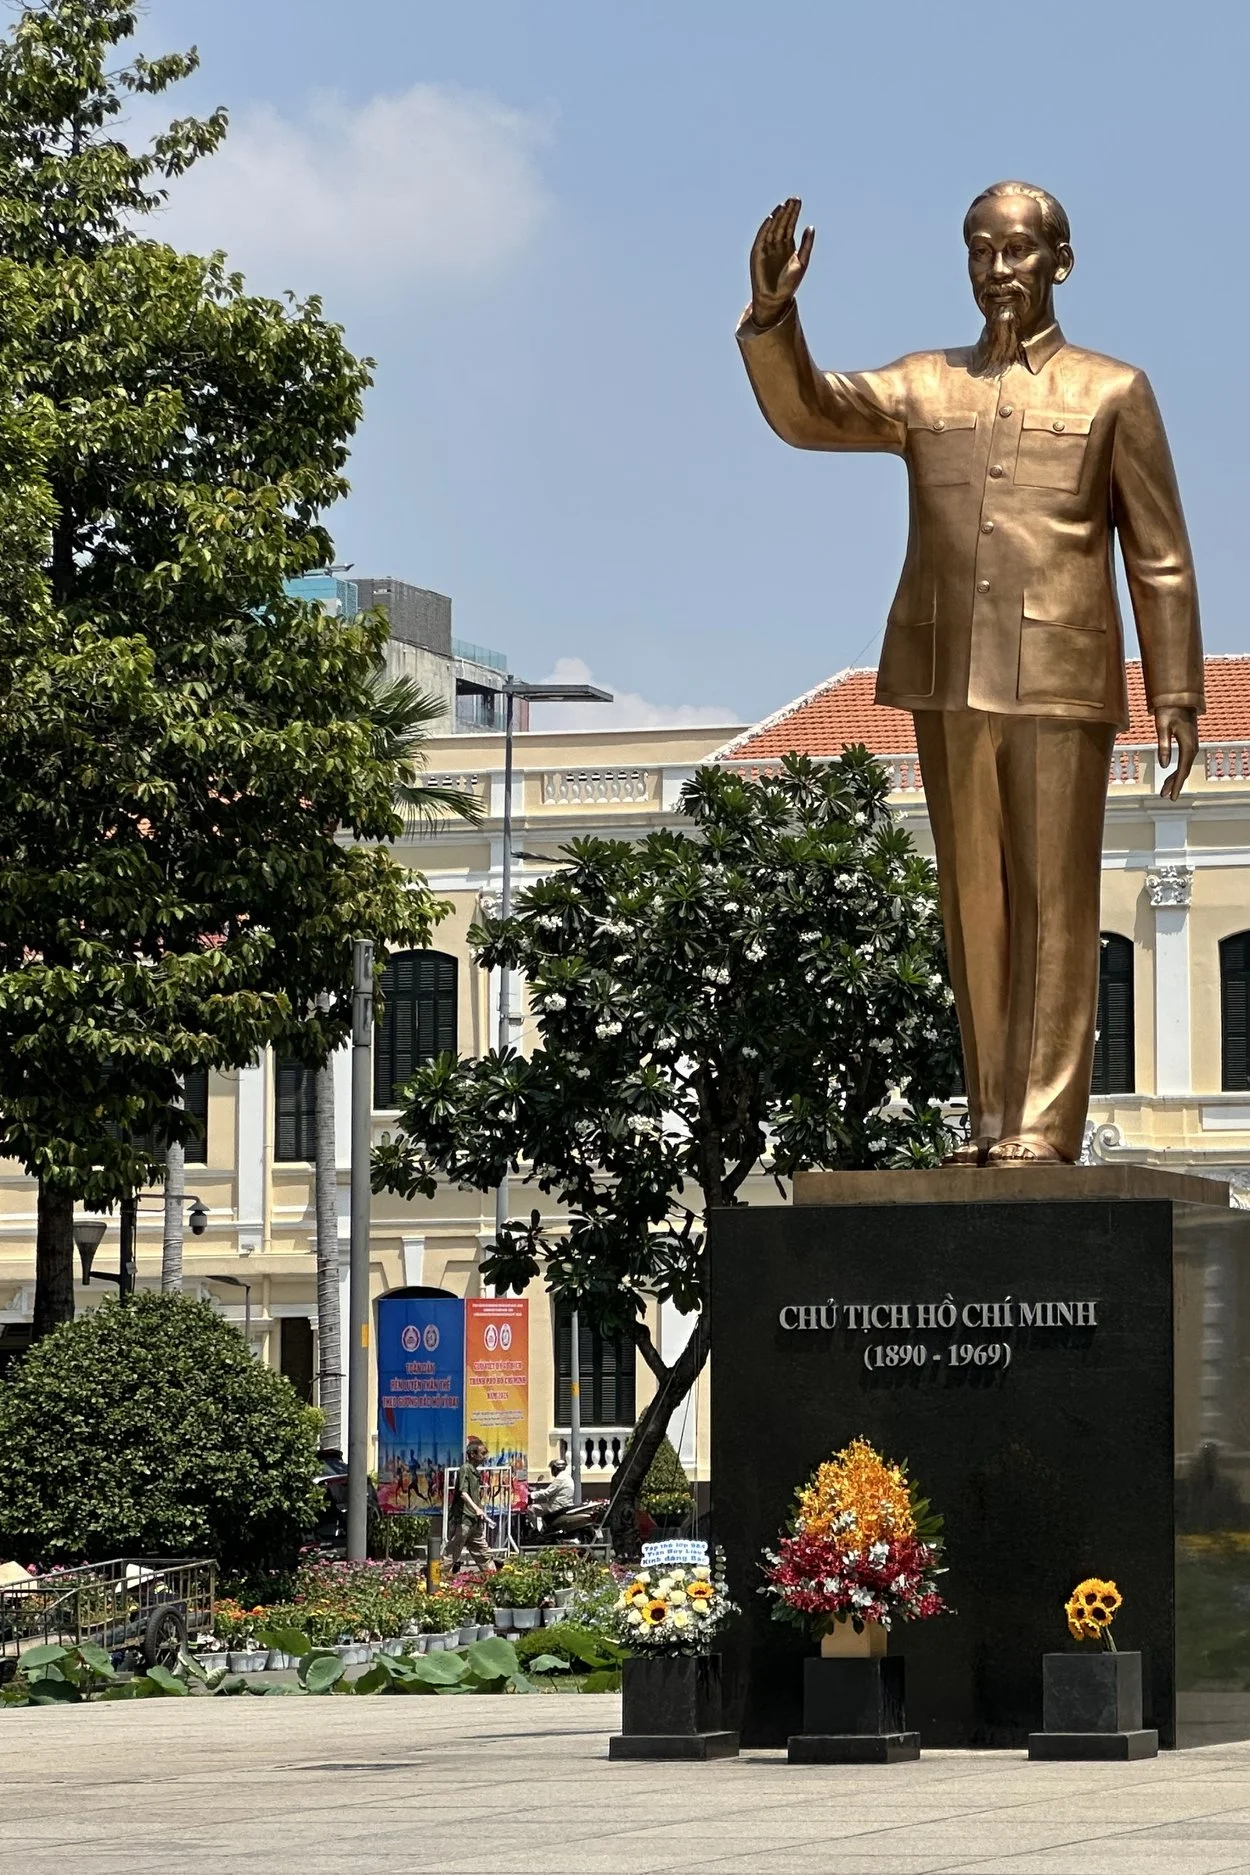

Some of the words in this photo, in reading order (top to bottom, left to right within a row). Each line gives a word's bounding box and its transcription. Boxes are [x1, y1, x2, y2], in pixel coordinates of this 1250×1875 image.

[779, 1298, 837, 1330] CHỦ
[843, 1304, 911, 1333] TỊCH
[916, 1292, 957, 1329] HỒ
[962, 1295, 1012, 1328] CHÍ
[1018, 1301, 1098, 1327] MINH
[863, 1344, 927, 1370] (1890
[947, 1342, 1011, 1368] 1969)
